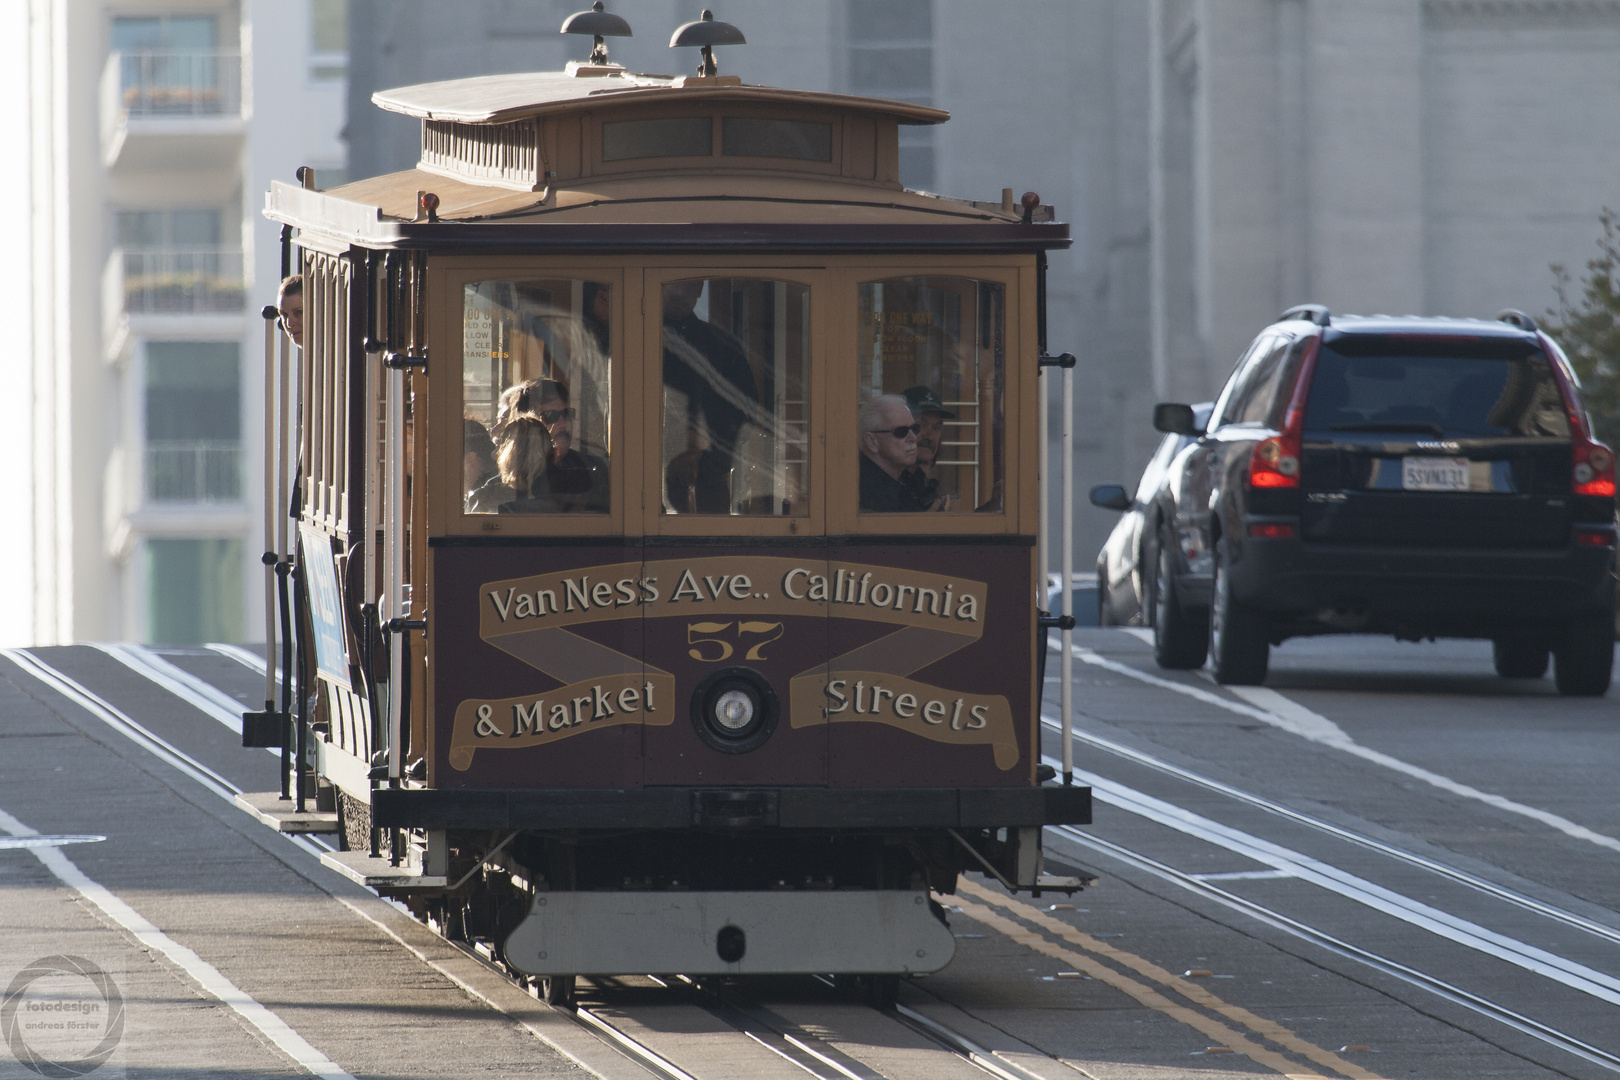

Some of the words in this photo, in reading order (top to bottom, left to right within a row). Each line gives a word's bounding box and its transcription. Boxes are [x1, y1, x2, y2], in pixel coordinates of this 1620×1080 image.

[784, 567, 979, 620] California
[687, 621, 784, 662] 57
[475, 703, 504, 736] &
[514, 679, 657, 732] Market
[824, 679, 990, 730] Streets
